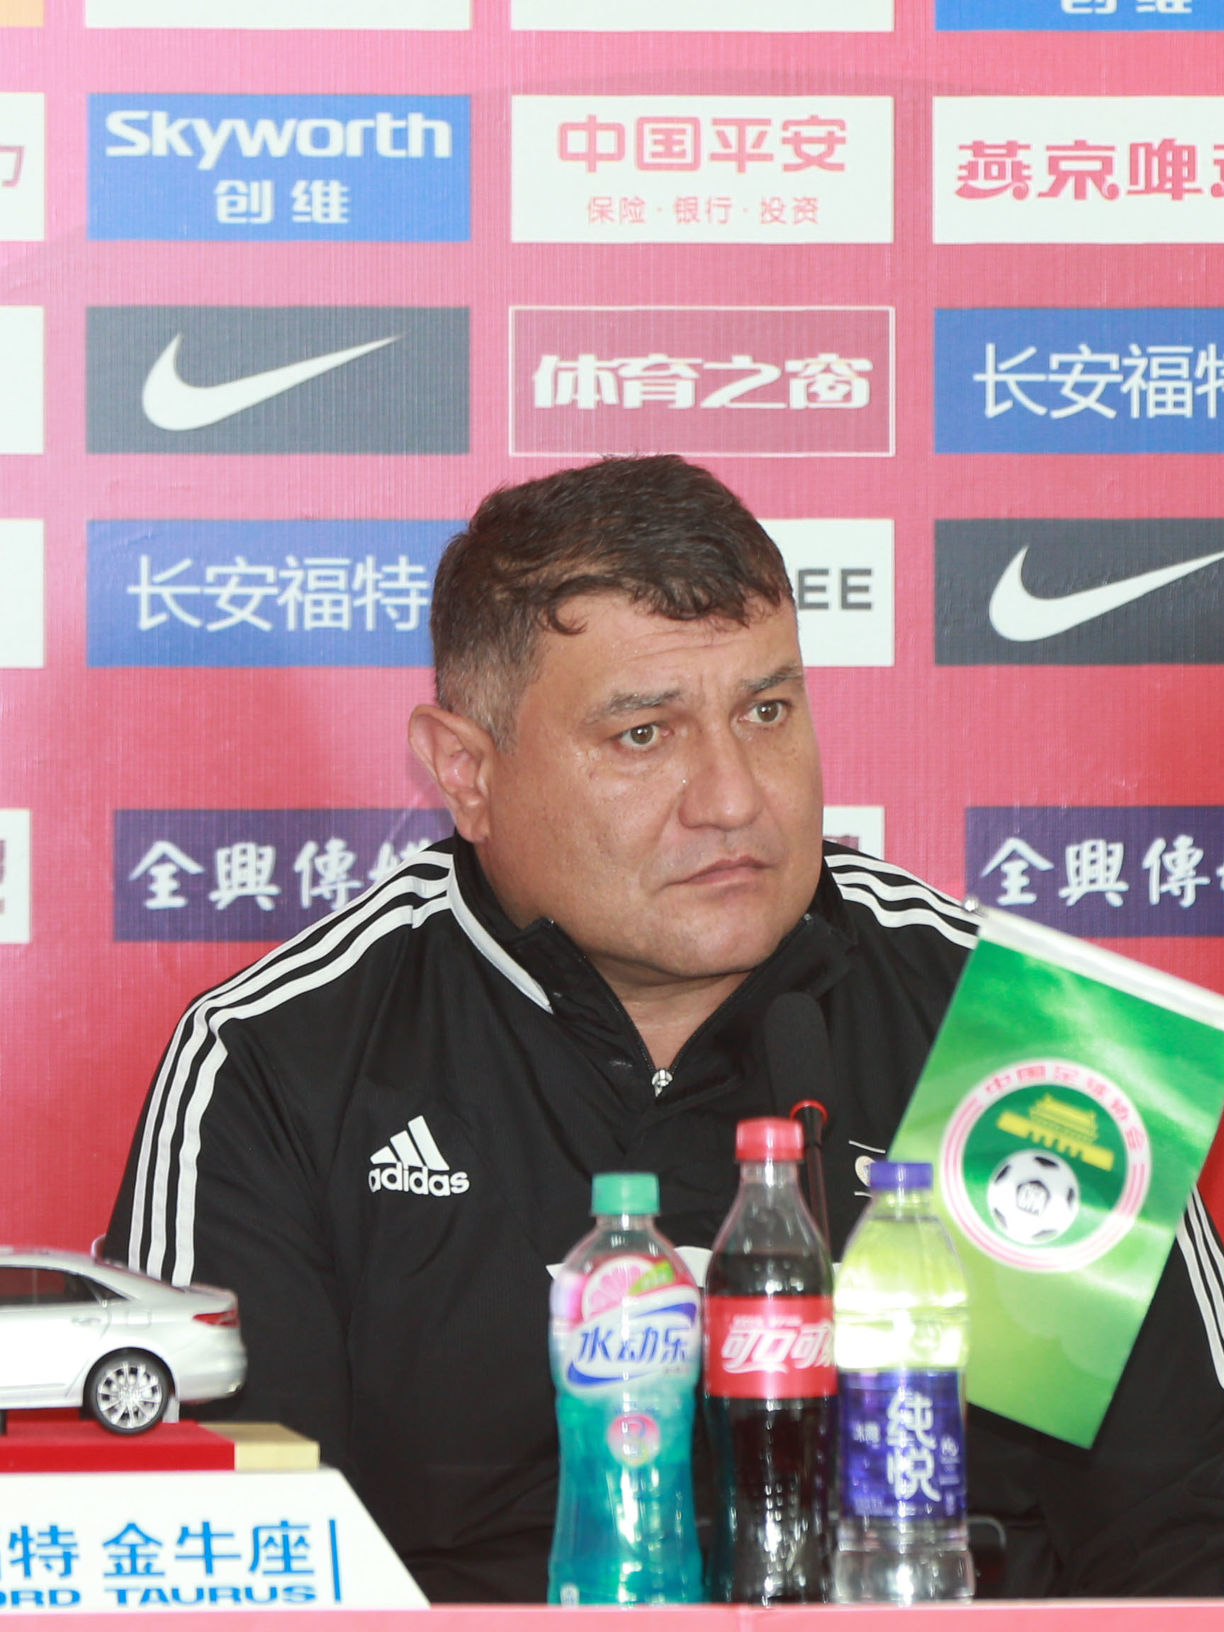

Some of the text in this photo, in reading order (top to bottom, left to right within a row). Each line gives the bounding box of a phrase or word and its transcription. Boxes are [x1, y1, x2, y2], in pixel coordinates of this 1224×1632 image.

[105, 111, 452, 170] Skyworth
[558, 114, 847, 174] 中国平安
[215, 180, 349, 224] 创维
[532, 352, 873, 410] 体育之窗
[126, 555, 430, 632] 长安福特
[368, 1161, 470, 1197] adidas
[103, 1519, 315, 1577] 金牛座
[104, 1585, 316, 1606] TAURUS
